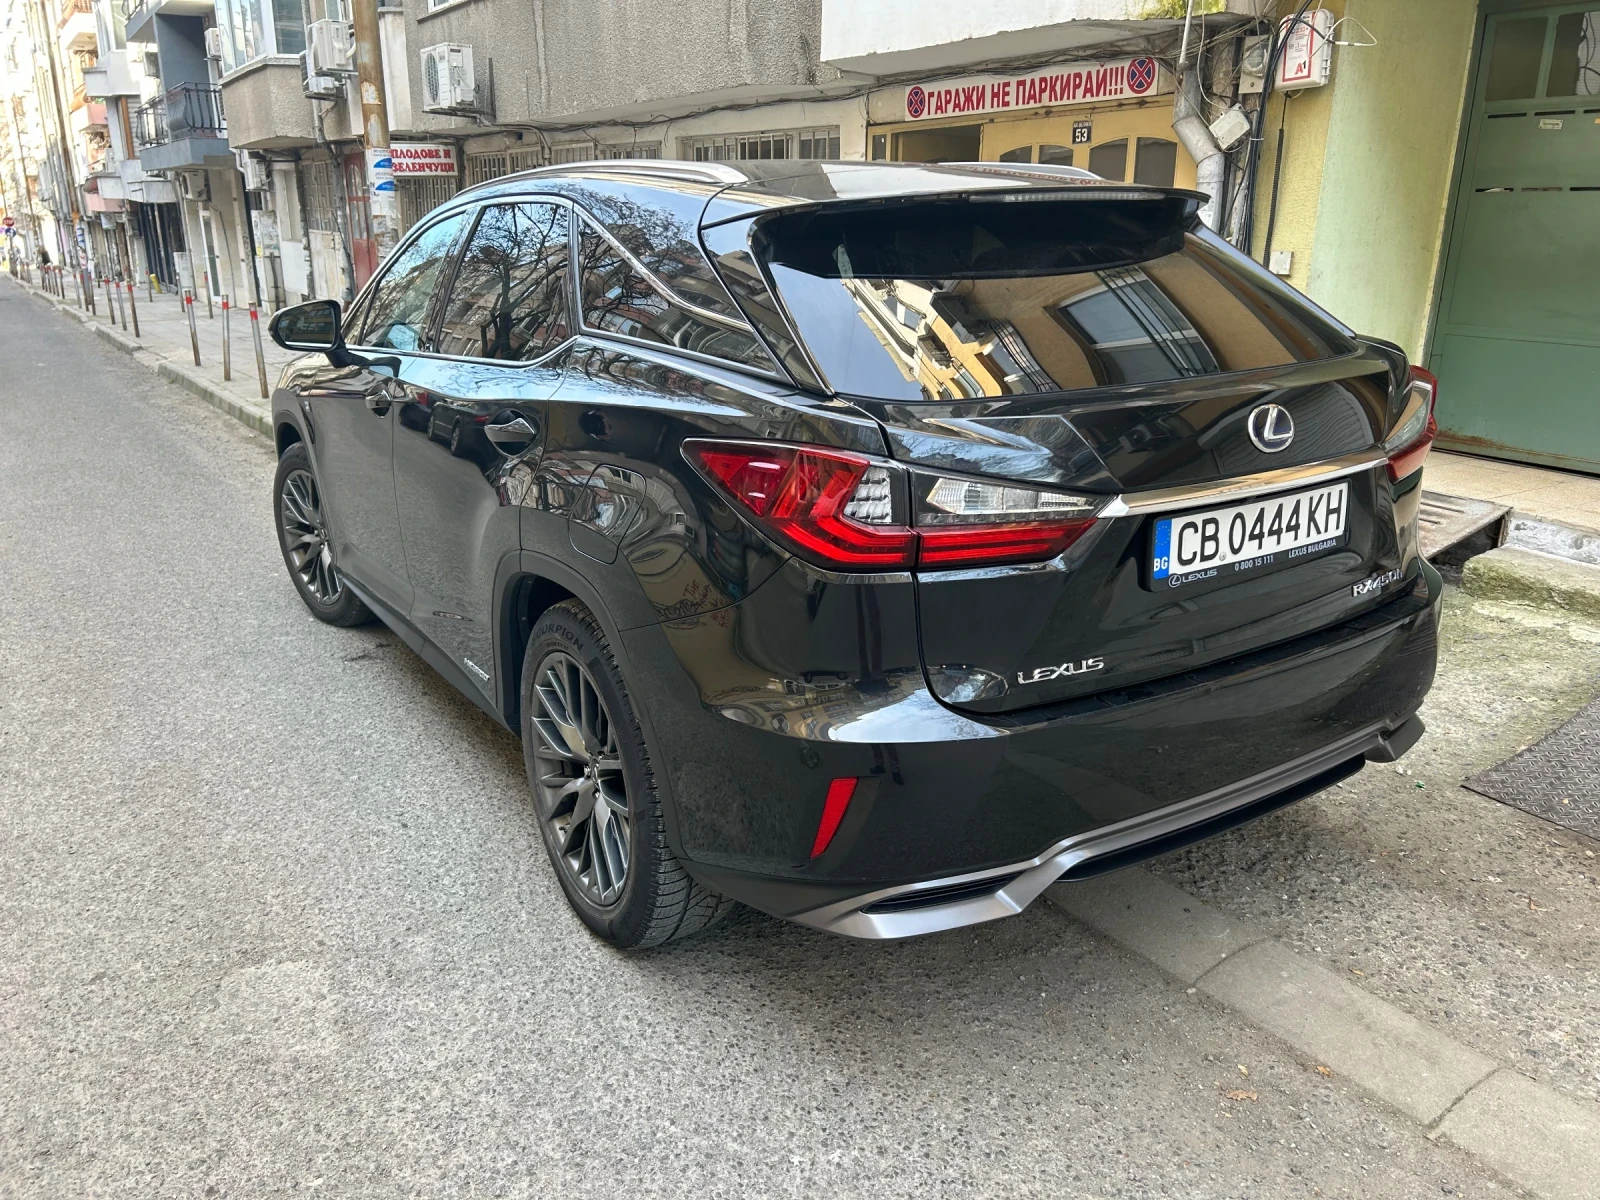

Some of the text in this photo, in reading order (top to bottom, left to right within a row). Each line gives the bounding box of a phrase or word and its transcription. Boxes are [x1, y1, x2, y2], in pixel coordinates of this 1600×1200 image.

[927, 62, 1125, 115] ГАРАЖИ НЕ ПАРКИРАЙ!!!
[1075, 128, 1088, 142] 53
[390, 148, 441, 160] ПЛОДОВЕ
[443, 149, 452, 159] И
[392, 162, 455, 173] ЗЕЛЕНЧУЦИ
[1288, 538, 1337, 558] LEXUS BULGARIA
[1153, 556, 1169, 571] BG
[1234, 555, 1274, 571] 0 800 15 111
[1182, 569, 1218, 583] LEXUS
[1017, 657, 1105, 685] LEXUS
